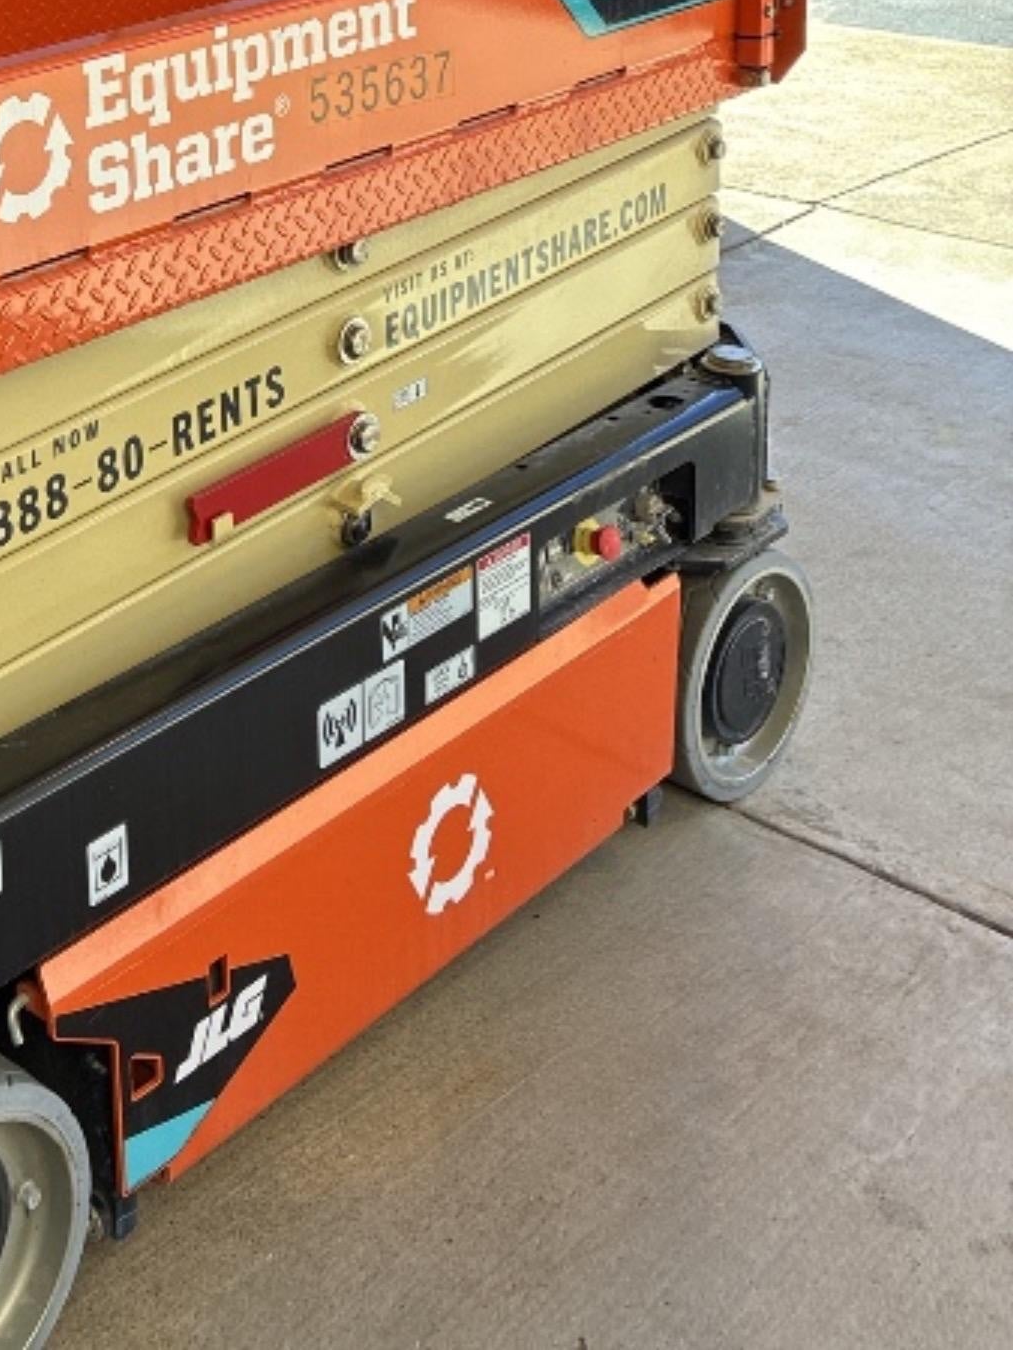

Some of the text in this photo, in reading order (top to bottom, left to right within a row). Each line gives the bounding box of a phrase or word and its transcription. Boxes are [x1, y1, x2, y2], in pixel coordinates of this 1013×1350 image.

[308, 51, 451, 124] 535637
[384, 182, 667, 348] EQUIPMENTSHARE.COM
[52, 419, 100, 458] NOW
[174, 973, 267, 1084] JLG
